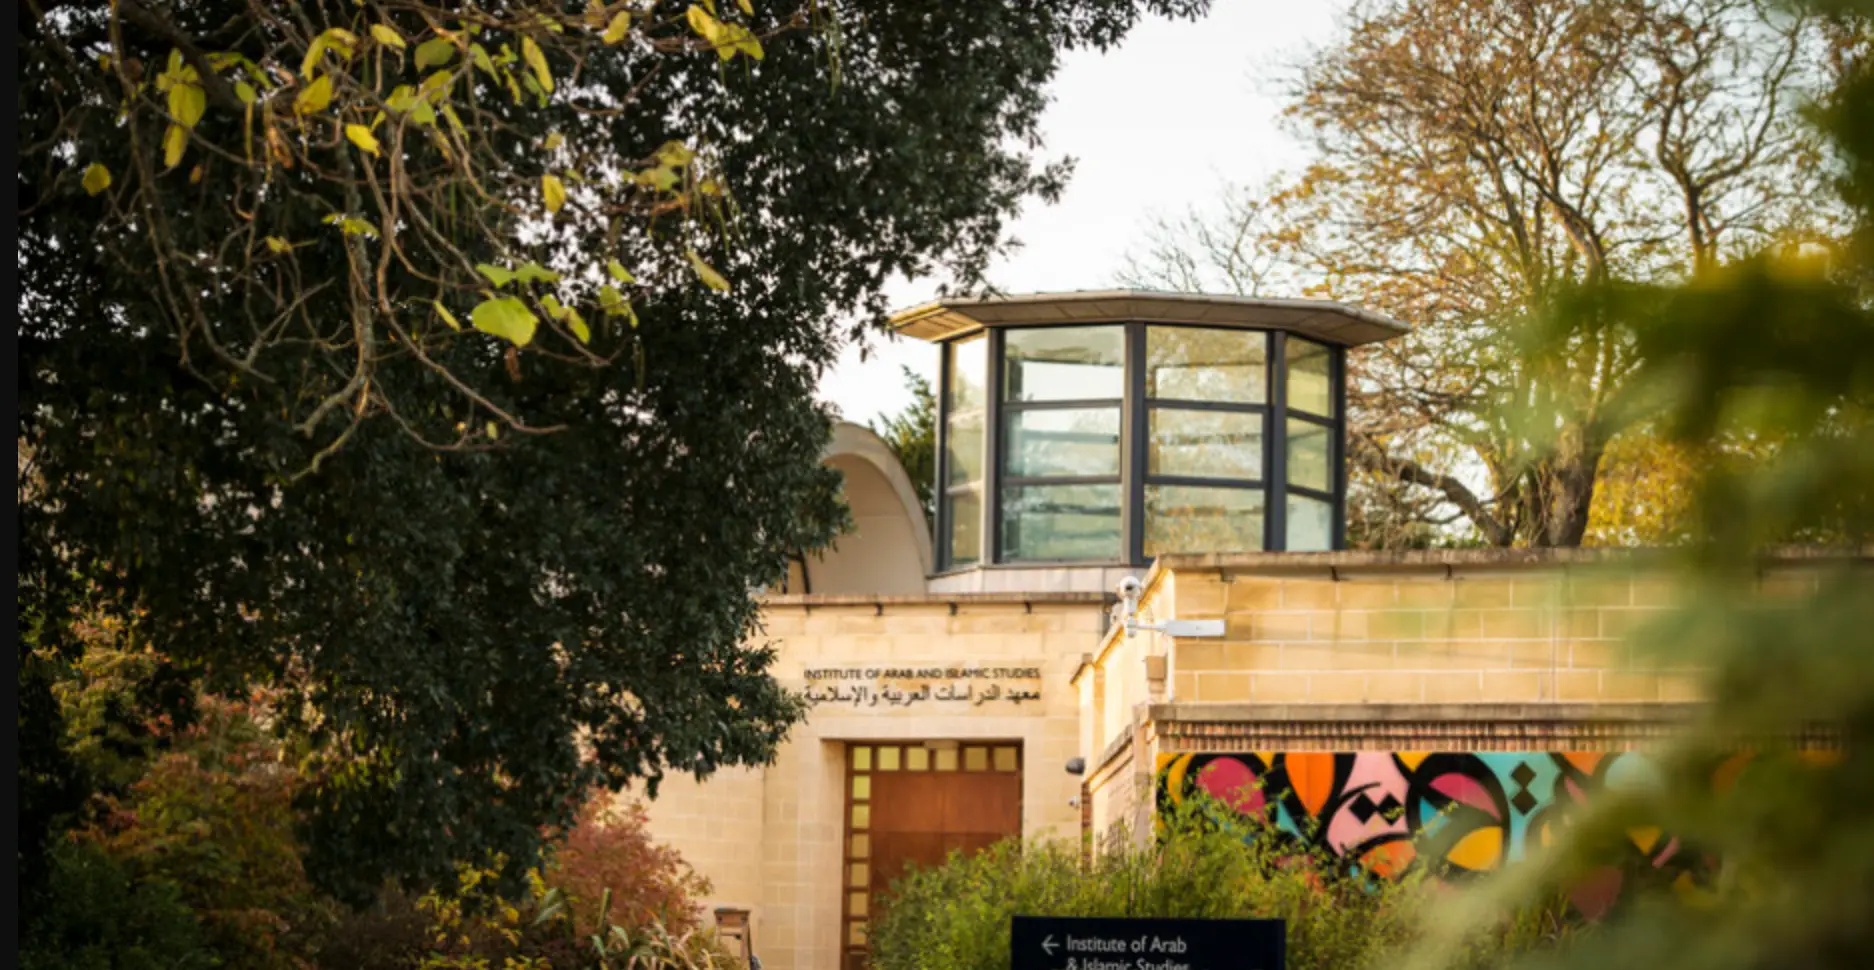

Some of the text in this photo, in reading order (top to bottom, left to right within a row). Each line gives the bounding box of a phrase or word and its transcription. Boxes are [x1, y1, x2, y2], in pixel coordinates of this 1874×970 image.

[803, 667, 1040, 680] INSTITUTE OF ARAB AND ISLAMIC STUDIES
[881, 683, 930, 707] العربية
[935, 683, 1001, 707] الدراسات
[1005, 688, 1040, 705] معهد
[1066, 934, 1187, 953] Institute of Arab
[1066, 957, 1190, 970] & Islamic Studies
